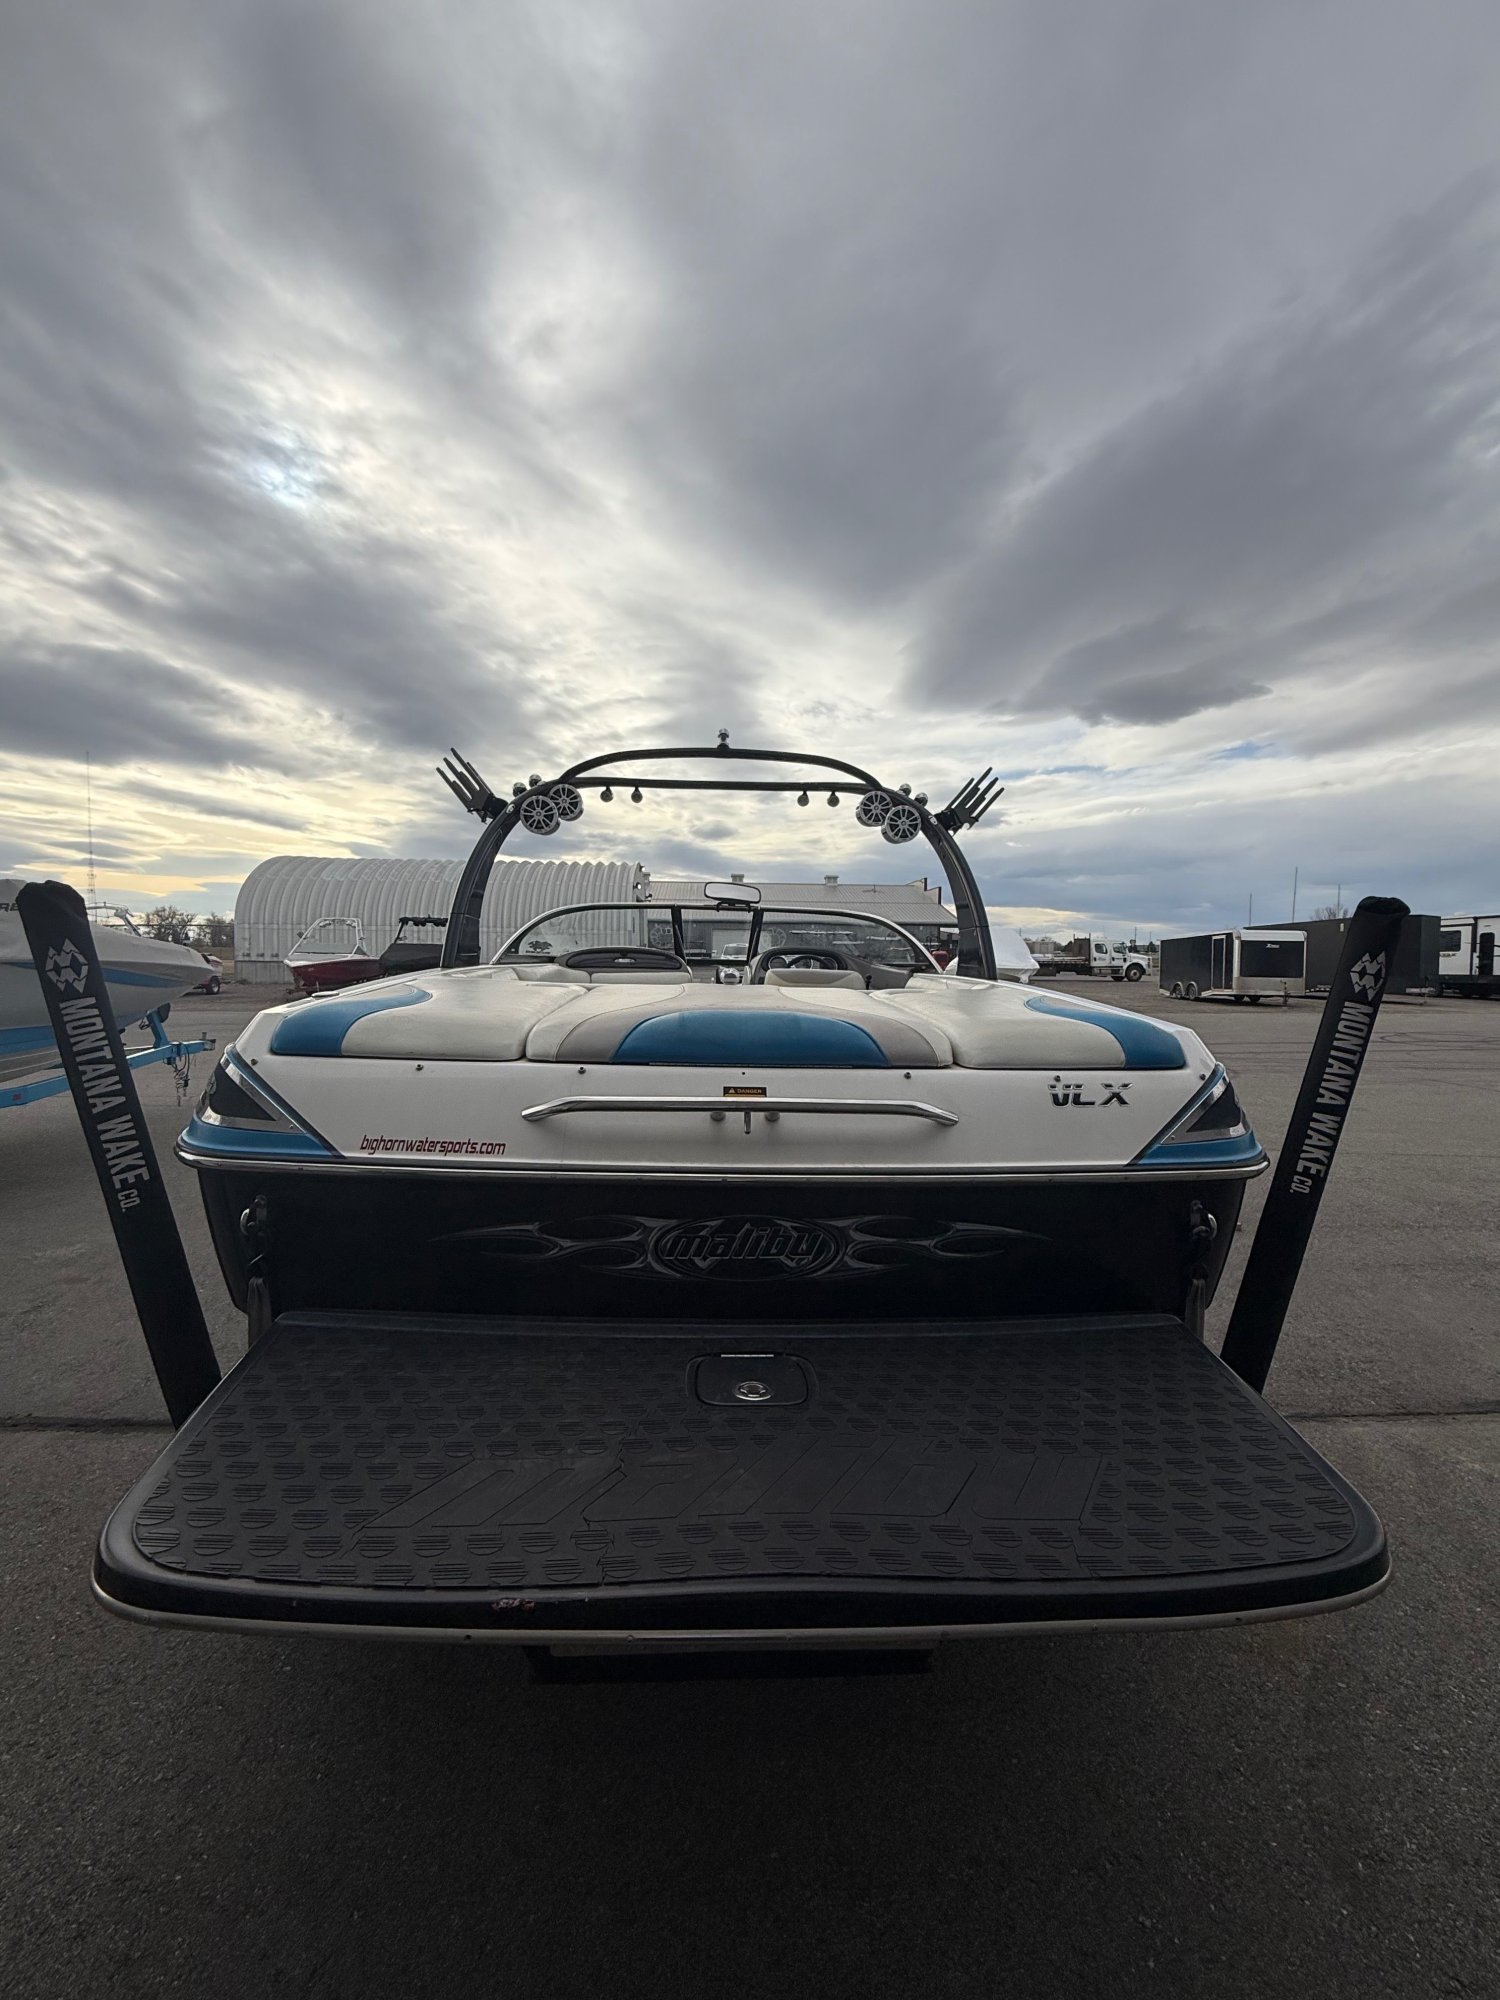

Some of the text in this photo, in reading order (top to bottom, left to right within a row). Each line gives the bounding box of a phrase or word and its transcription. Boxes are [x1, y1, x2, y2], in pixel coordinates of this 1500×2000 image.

[60, 997, 150, 1213] MONTANA WAKE CO.
[360, 1134, 506, 1156] bighornwatersports.com
[1289, 1001, 1374, 1194] MONTANA WAKE CO.
